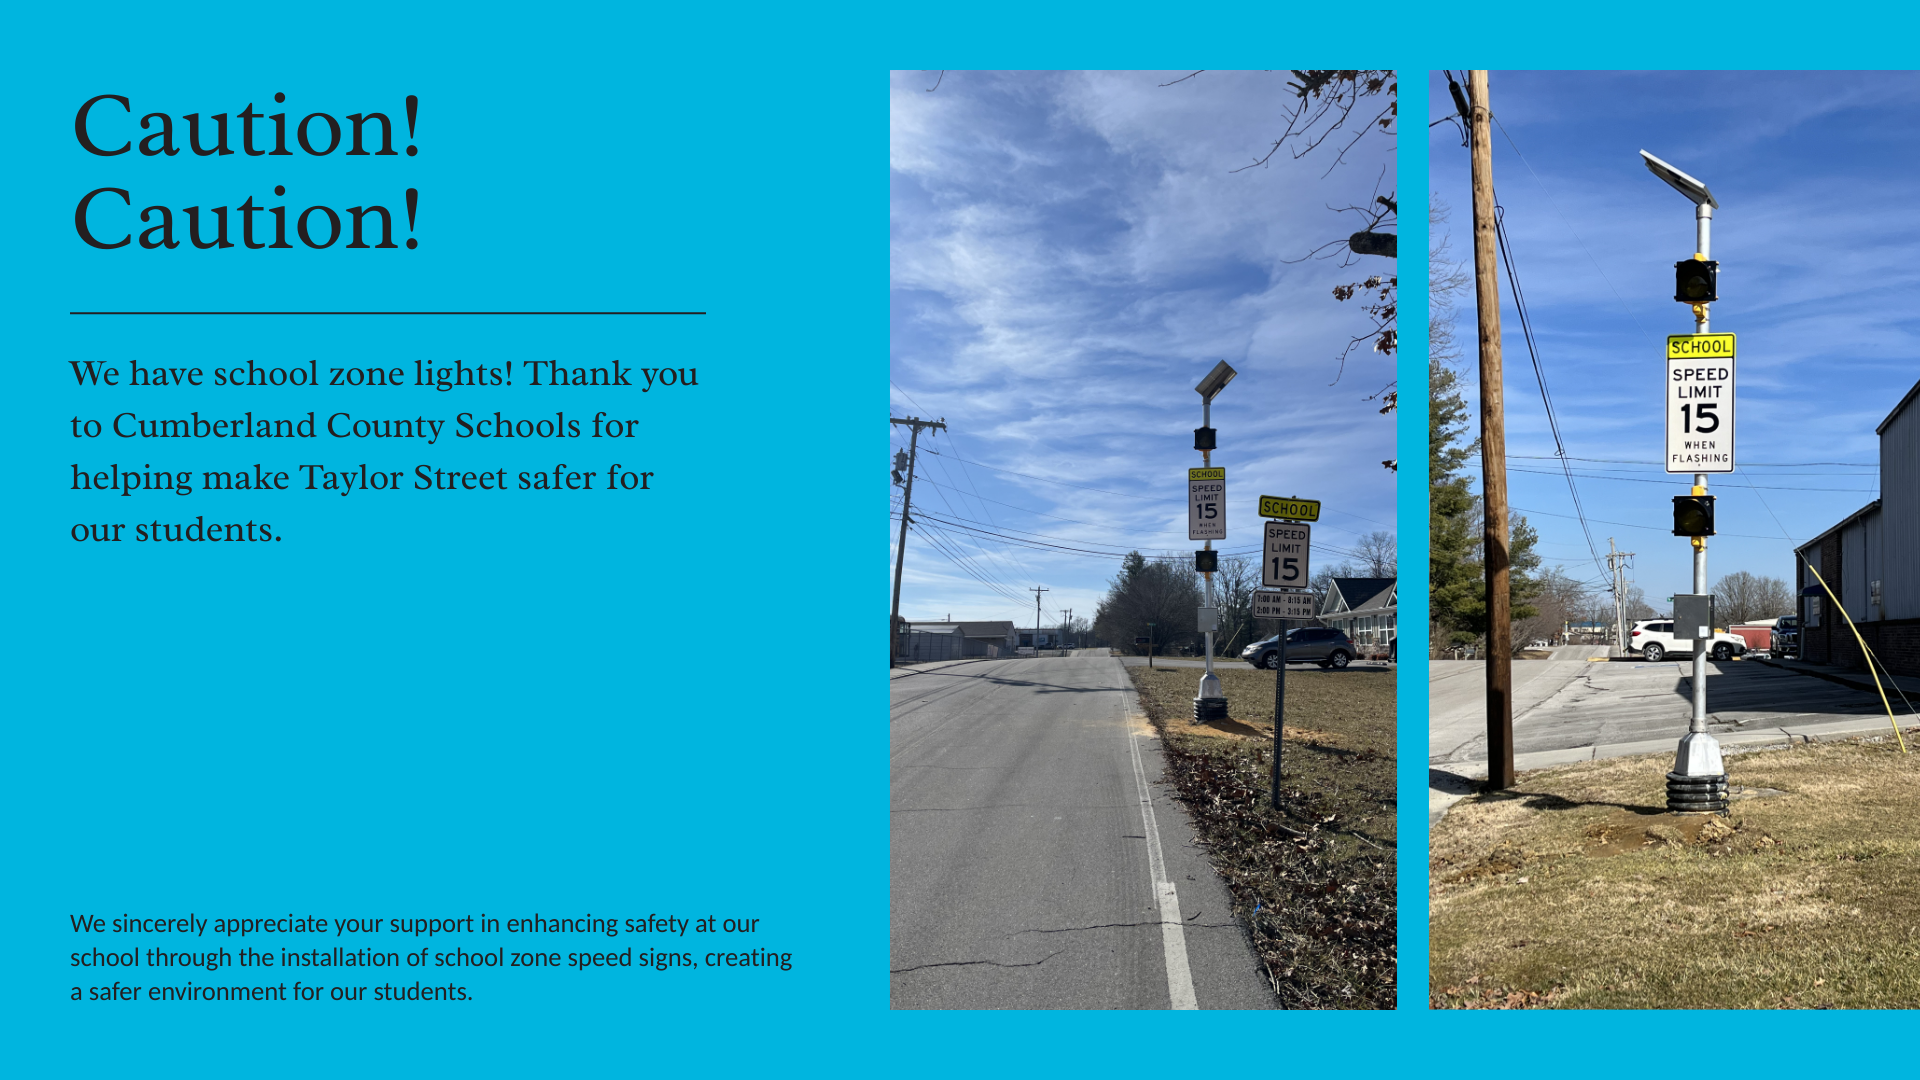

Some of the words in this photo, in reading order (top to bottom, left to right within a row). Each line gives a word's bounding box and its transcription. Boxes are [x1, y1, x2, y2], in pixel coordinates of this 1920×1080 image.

[1672, 340, 1730, 354] SCHOOL
[1673, 368, 1729, 381] SPEED
[1678, 386, 1722, 399] LIMIT
[1681, 403, 1720, 434] 15
[1684, 441, 1716, 450] WHEN
[1672, 454, 1728, 463] FLASHING
[1191, 470, 1223, 479] SCHOOL
[1192, 484, 1222, 492] SPEED
[1196, 503, 1218, 519] 15
[1264, 501, 1316, 517] SCHOOL
[1268, 529, 1306, 540] SPEED
[1271, 543, 1301, 554] LIMIT
[1271, 556, 1300, 581] 15
[1257, 594, 1270, 603] 7:00
[1272, 595, 1281, 603] AM
[1287, 596, 1301, 604] 8:15
[1302, 596, 1312, 605] AM
[1256, 606, 1270, 614] 2:00
[1271, 606, 1281, 615] PM
[1287, 607, 1300, 615] 3:15
[1302, 608, 1311, 616] PM
